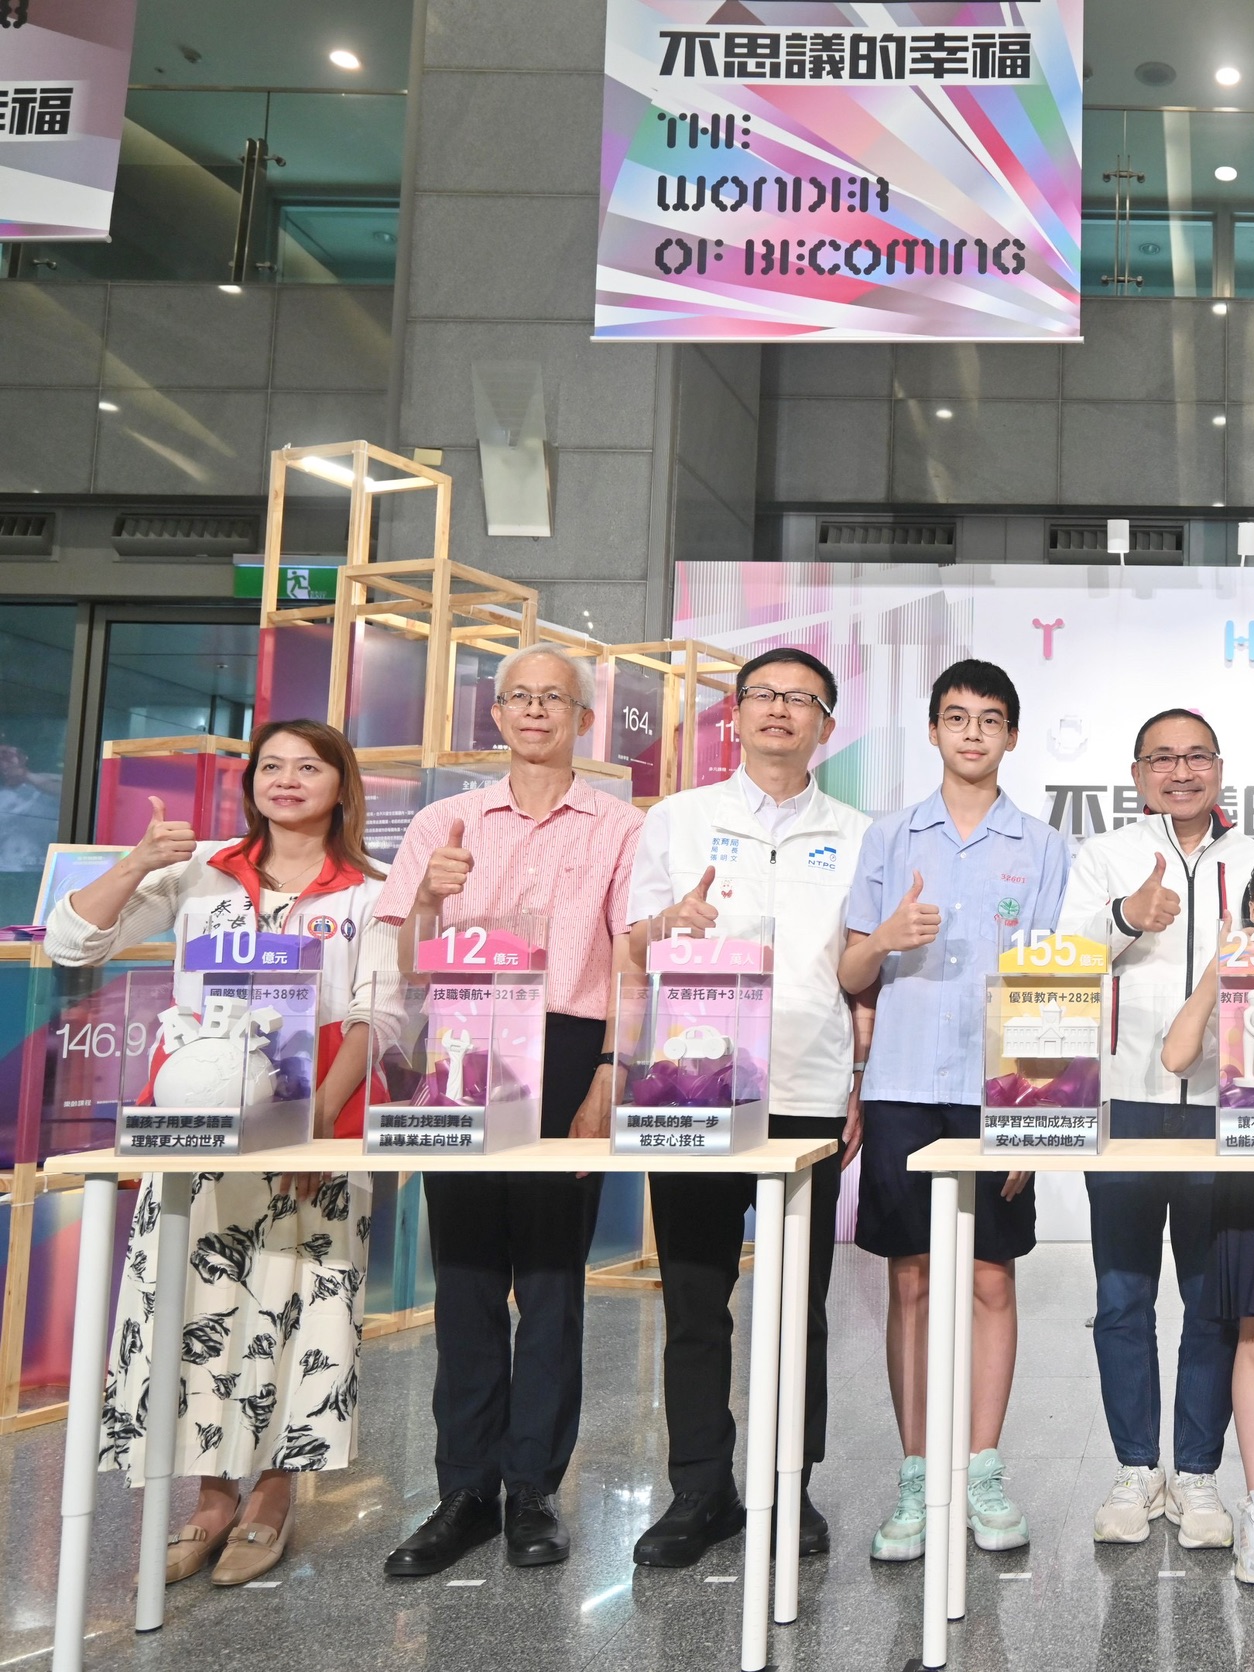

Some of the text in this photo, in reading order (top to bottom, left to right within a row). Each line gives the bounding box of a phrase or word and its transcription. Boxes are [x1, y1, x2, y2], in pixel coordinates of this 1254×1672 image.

[659, 31, 1031, 79] 不思議的幸福
[0, 87, 74, 135] 福
[657, 113, 751, 149] THE
[657, 175, 890, 213] WONDER
[655, 238, 1026, 276] OF BECOMING
[808, 859, 836, 870] NTPC
[210, 929, 288, 965] 10 億元
[441, 926, 519, 966] 12 億元
[669, 927, 729, 965] 5.7
[1010, 929, 1104, 967] 155 億元
[667, 988, 763, 1000] 友善托育+324班
[126, 1115, 234, 1129] 讓孩子用更多語言
[380, 1114, 474, 1128] 讓能力找到舞台
[627, 1114, 719, 1128] 讓成長的第一步
[985, 1115, 1097, 1129] 讓學習空間成為孩子
[131, 1135, 225, 1148] 理解更大的世界
[379, 1133, 472, 1147] 讓專業走向世界
[639, 1134, 705, 1147] 被安心接住
[996, 1134, 1086, 1147] 安心長大的地方
